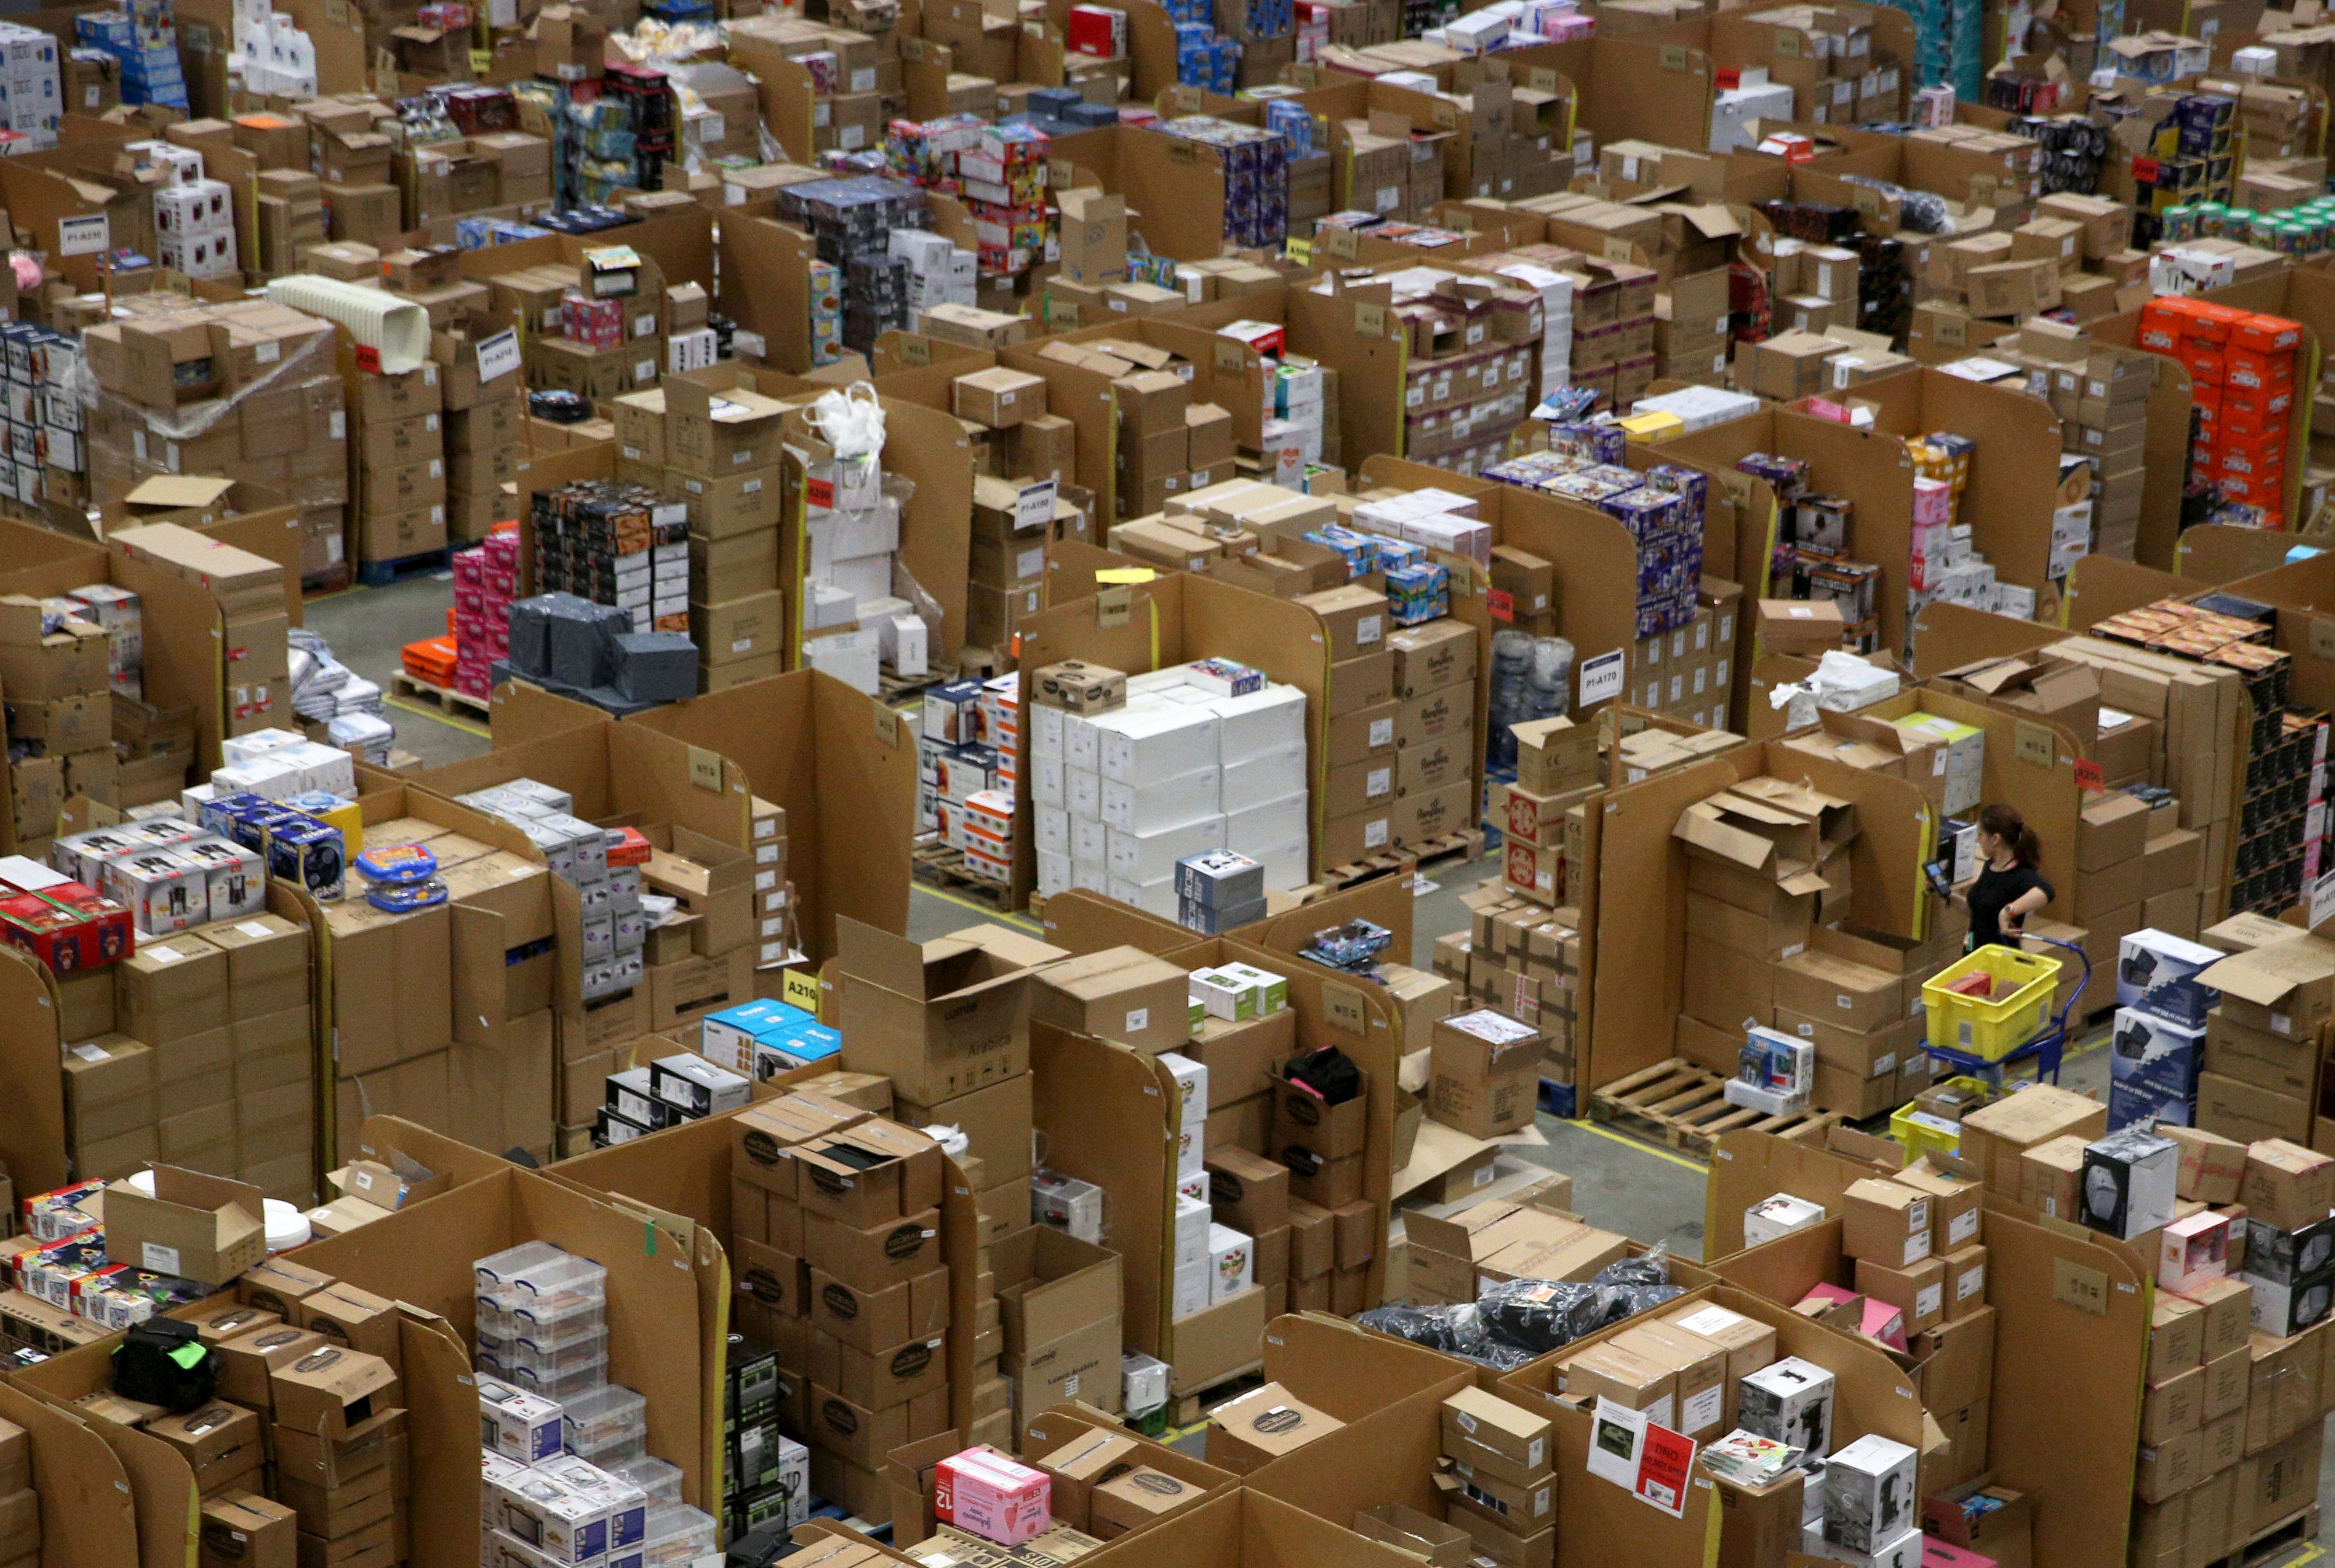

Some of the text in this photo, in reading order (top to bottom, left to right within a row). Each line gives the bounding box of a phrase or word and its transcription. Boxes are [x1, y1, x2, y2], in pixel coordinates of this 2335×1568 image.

[1585, 672, 1617, 689] P1-A170
[788, 981, 815, 1000] A210
[968, 1034, 1012, 1058] Arabica
[1654, 1444, 1678, 1462] DNO
[1654, 1459, 1667, 1471] NOT
[936, 1489, 953, 1510] 12
[1020, 1552, 1057, 1568] TOYS
